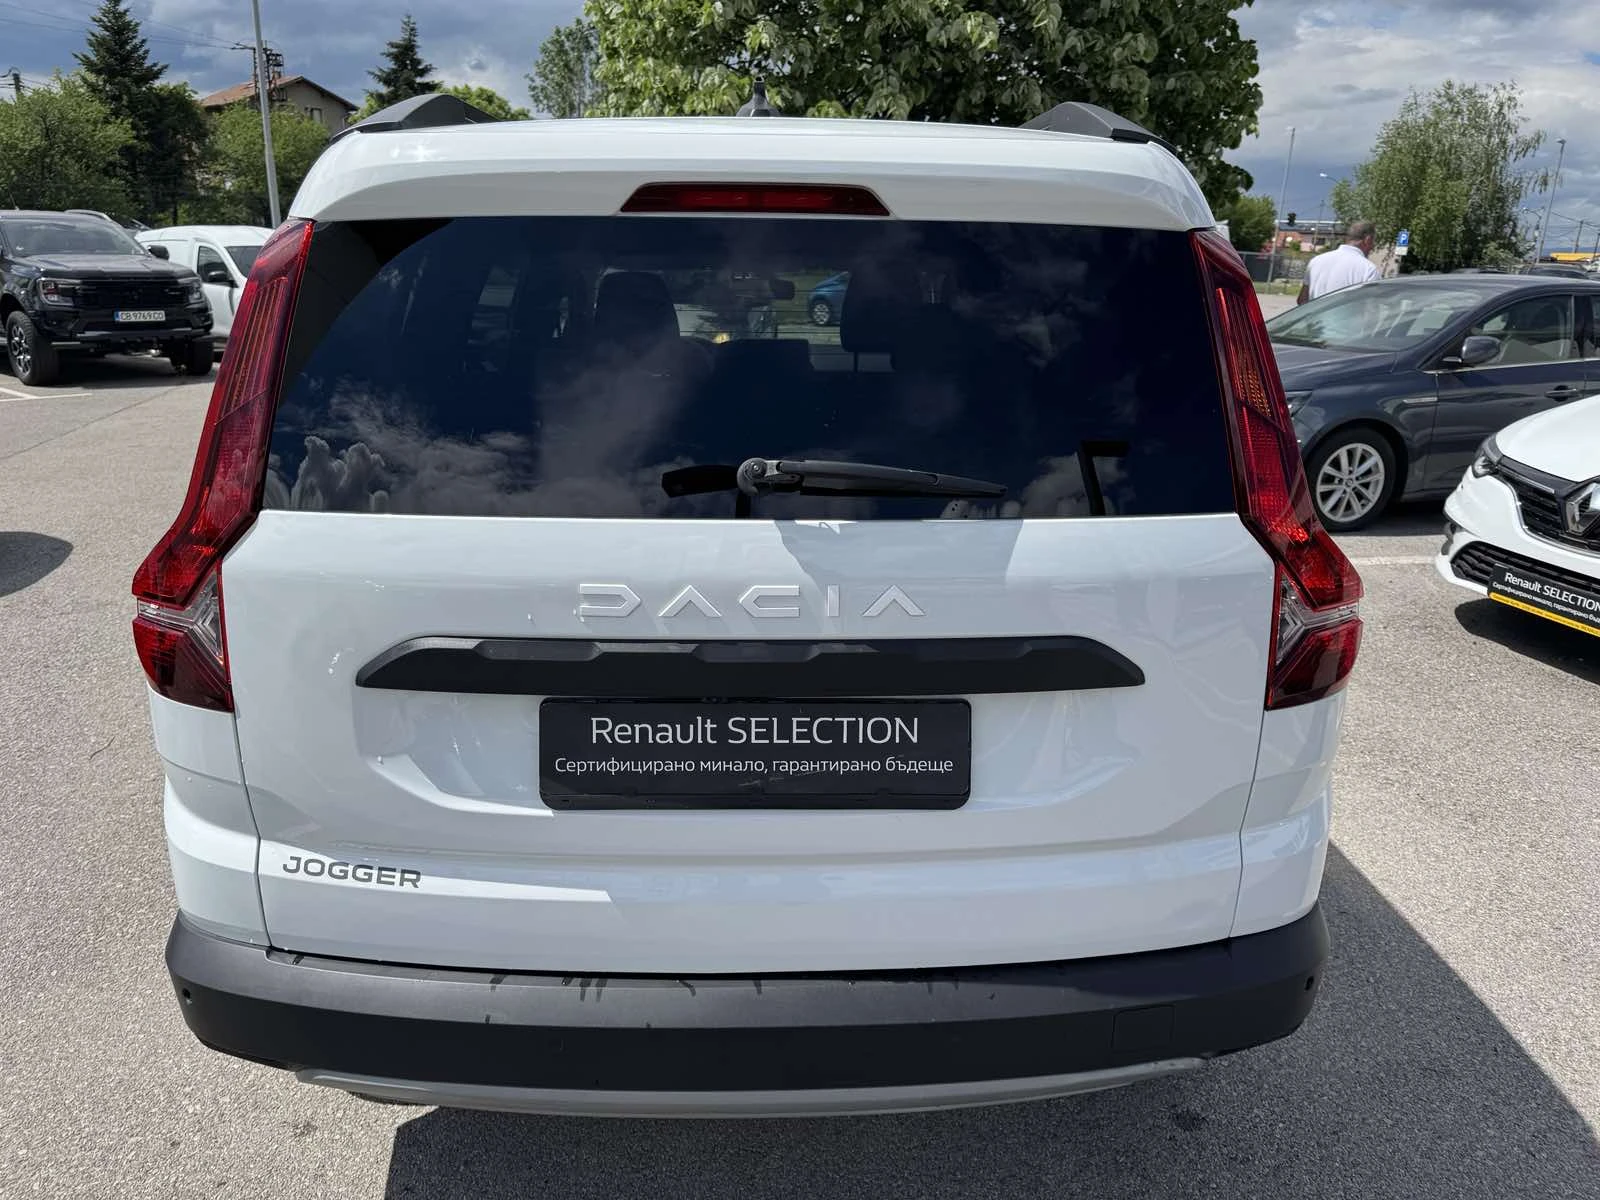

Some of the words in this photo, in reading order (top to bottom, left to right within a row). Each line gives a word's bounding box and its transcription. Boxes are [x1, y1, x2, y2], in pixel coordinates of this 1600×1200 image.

[579, 584, 925, 617] DACIA
[1504, 571, 1542, 593] Renault
[1542, 585, 1600, 611] SELECTION
[591, 716, 717, 744] Renault
[727, 716, 918, 744] SELECTION
[555, 757, 695, 775] Сертифицирано
[699, 760, 768, 774] минало,
[773, 760, 881, 775] гарантирано
[885, 756, 953, 774] бъдеще
[282, 855, 421, 888] JOGGER
